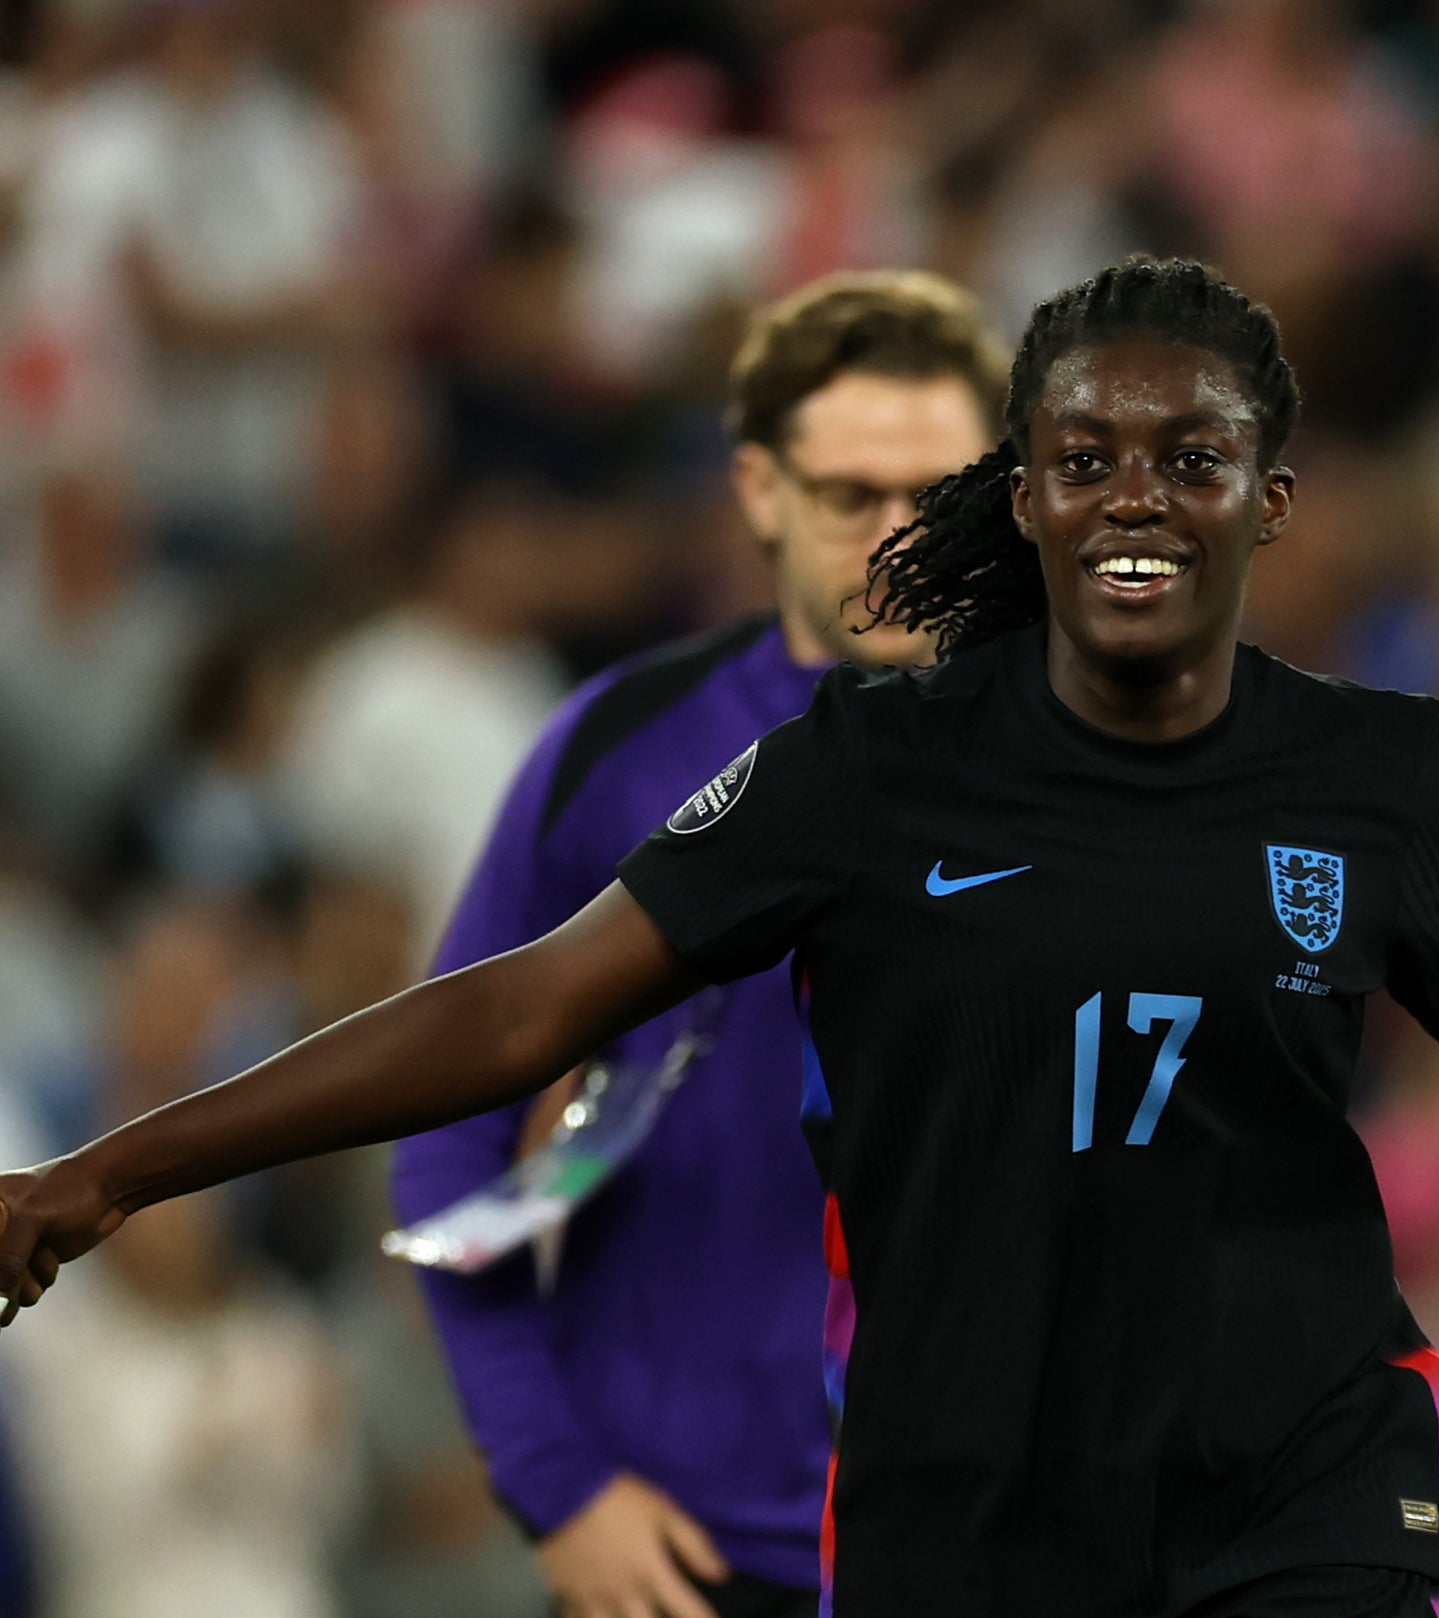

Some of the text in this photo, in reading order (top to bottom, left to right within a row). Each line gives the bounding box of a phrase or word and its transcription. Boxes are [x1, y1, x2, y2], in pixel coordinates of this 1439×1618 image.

[1295, 961, 1320, 979] ITALY
[1275, 974, 1332, 997] 22 JULY 2025
[1072, 991, 1204, 1153] 17
